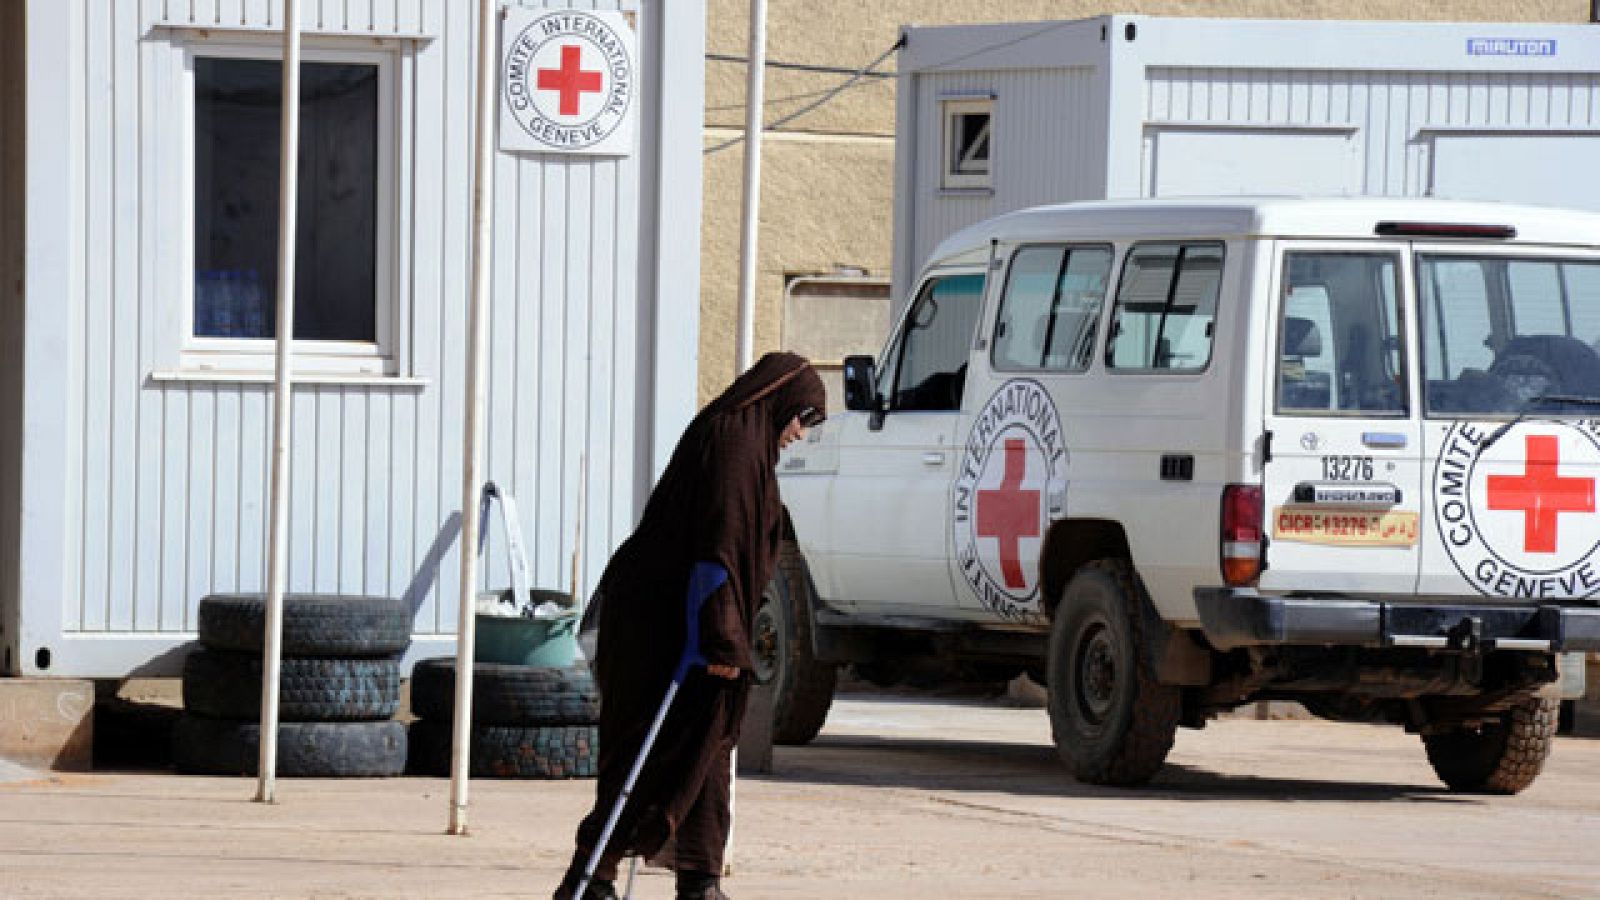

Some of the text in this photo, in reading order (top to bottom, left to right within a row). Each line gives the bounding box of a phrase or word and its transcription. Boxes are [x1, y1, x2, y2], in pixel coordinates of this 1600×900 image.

[509, 16, 626, 115] COMITE INTERNATIONAL
[529, 116, 602, 143] GENEVE
[1321, 455, 1373, 480] 13276
[1441, 421, 1487, 547] COMITE
